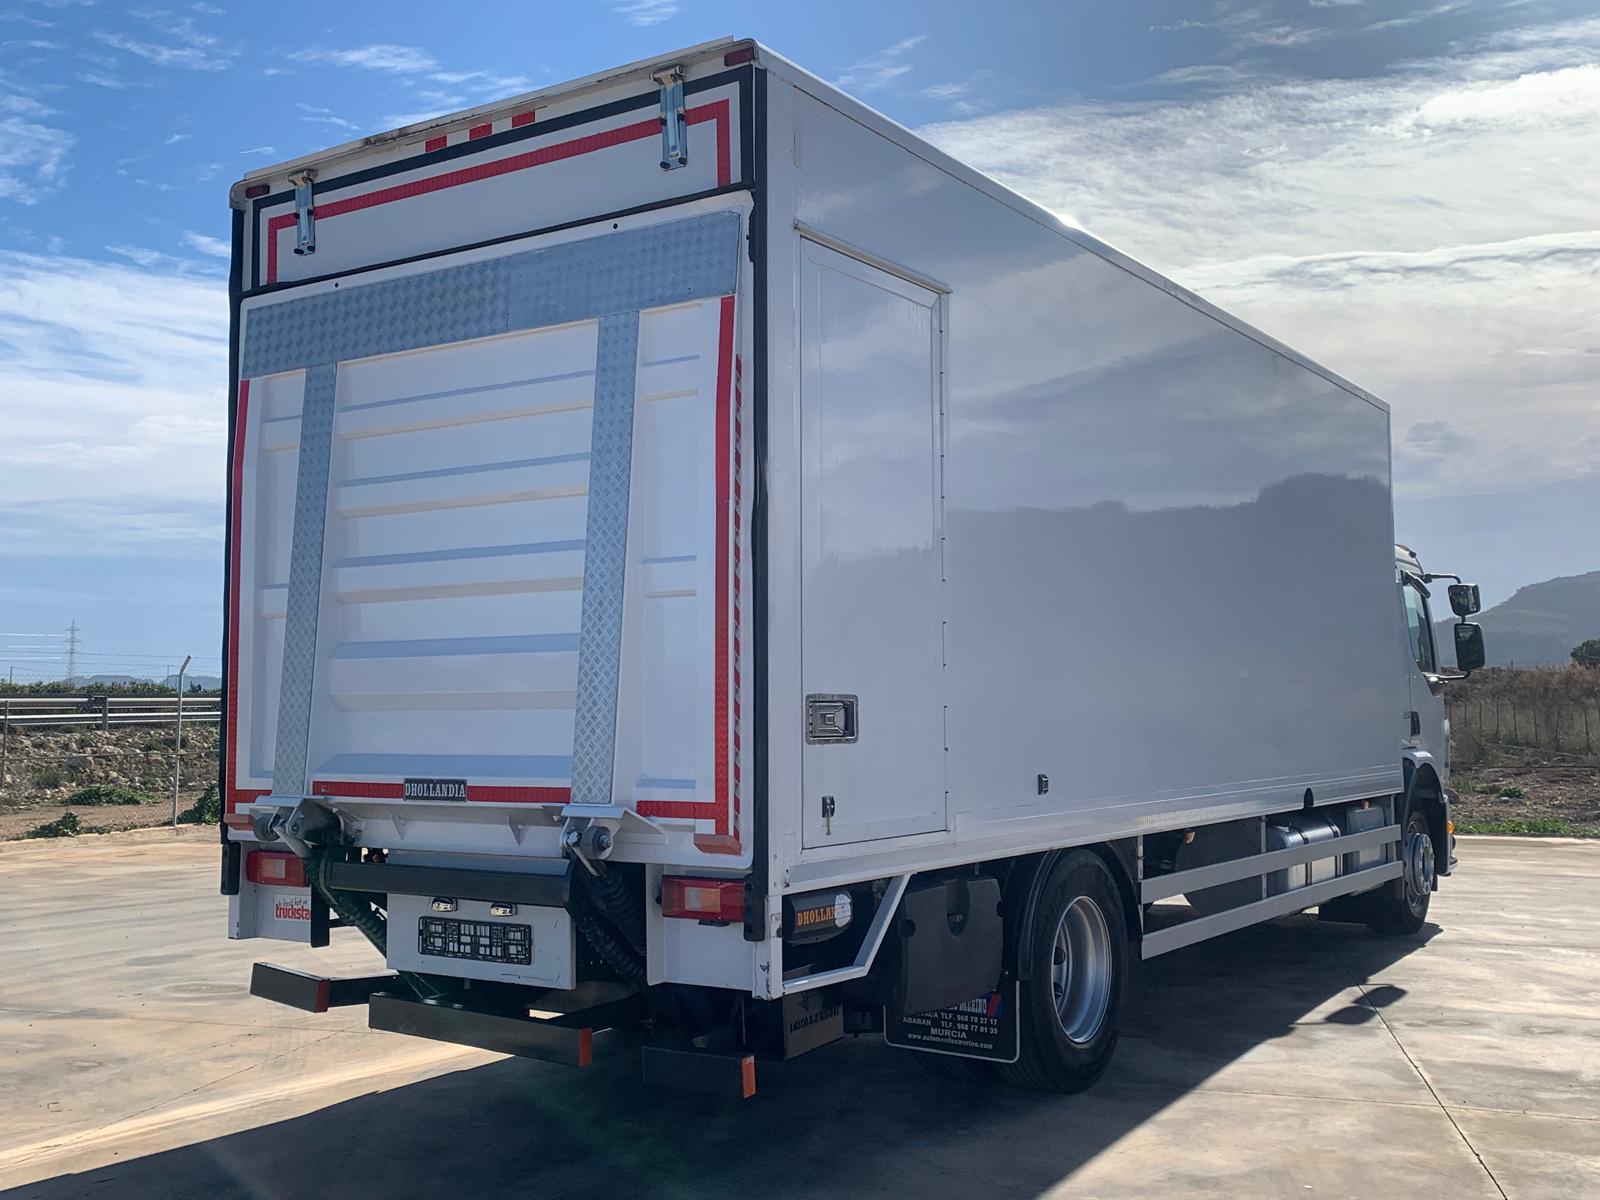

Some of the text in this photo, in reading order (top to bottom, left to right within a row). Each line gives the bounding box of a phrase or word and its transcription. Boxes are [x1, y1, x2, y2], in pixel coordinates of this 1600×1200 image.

[404, 783, 466, 798] DHOLLANDIA
[275, 903, 310, 920] trucksta
[930, 1027, 968, 1039] MURCIA
